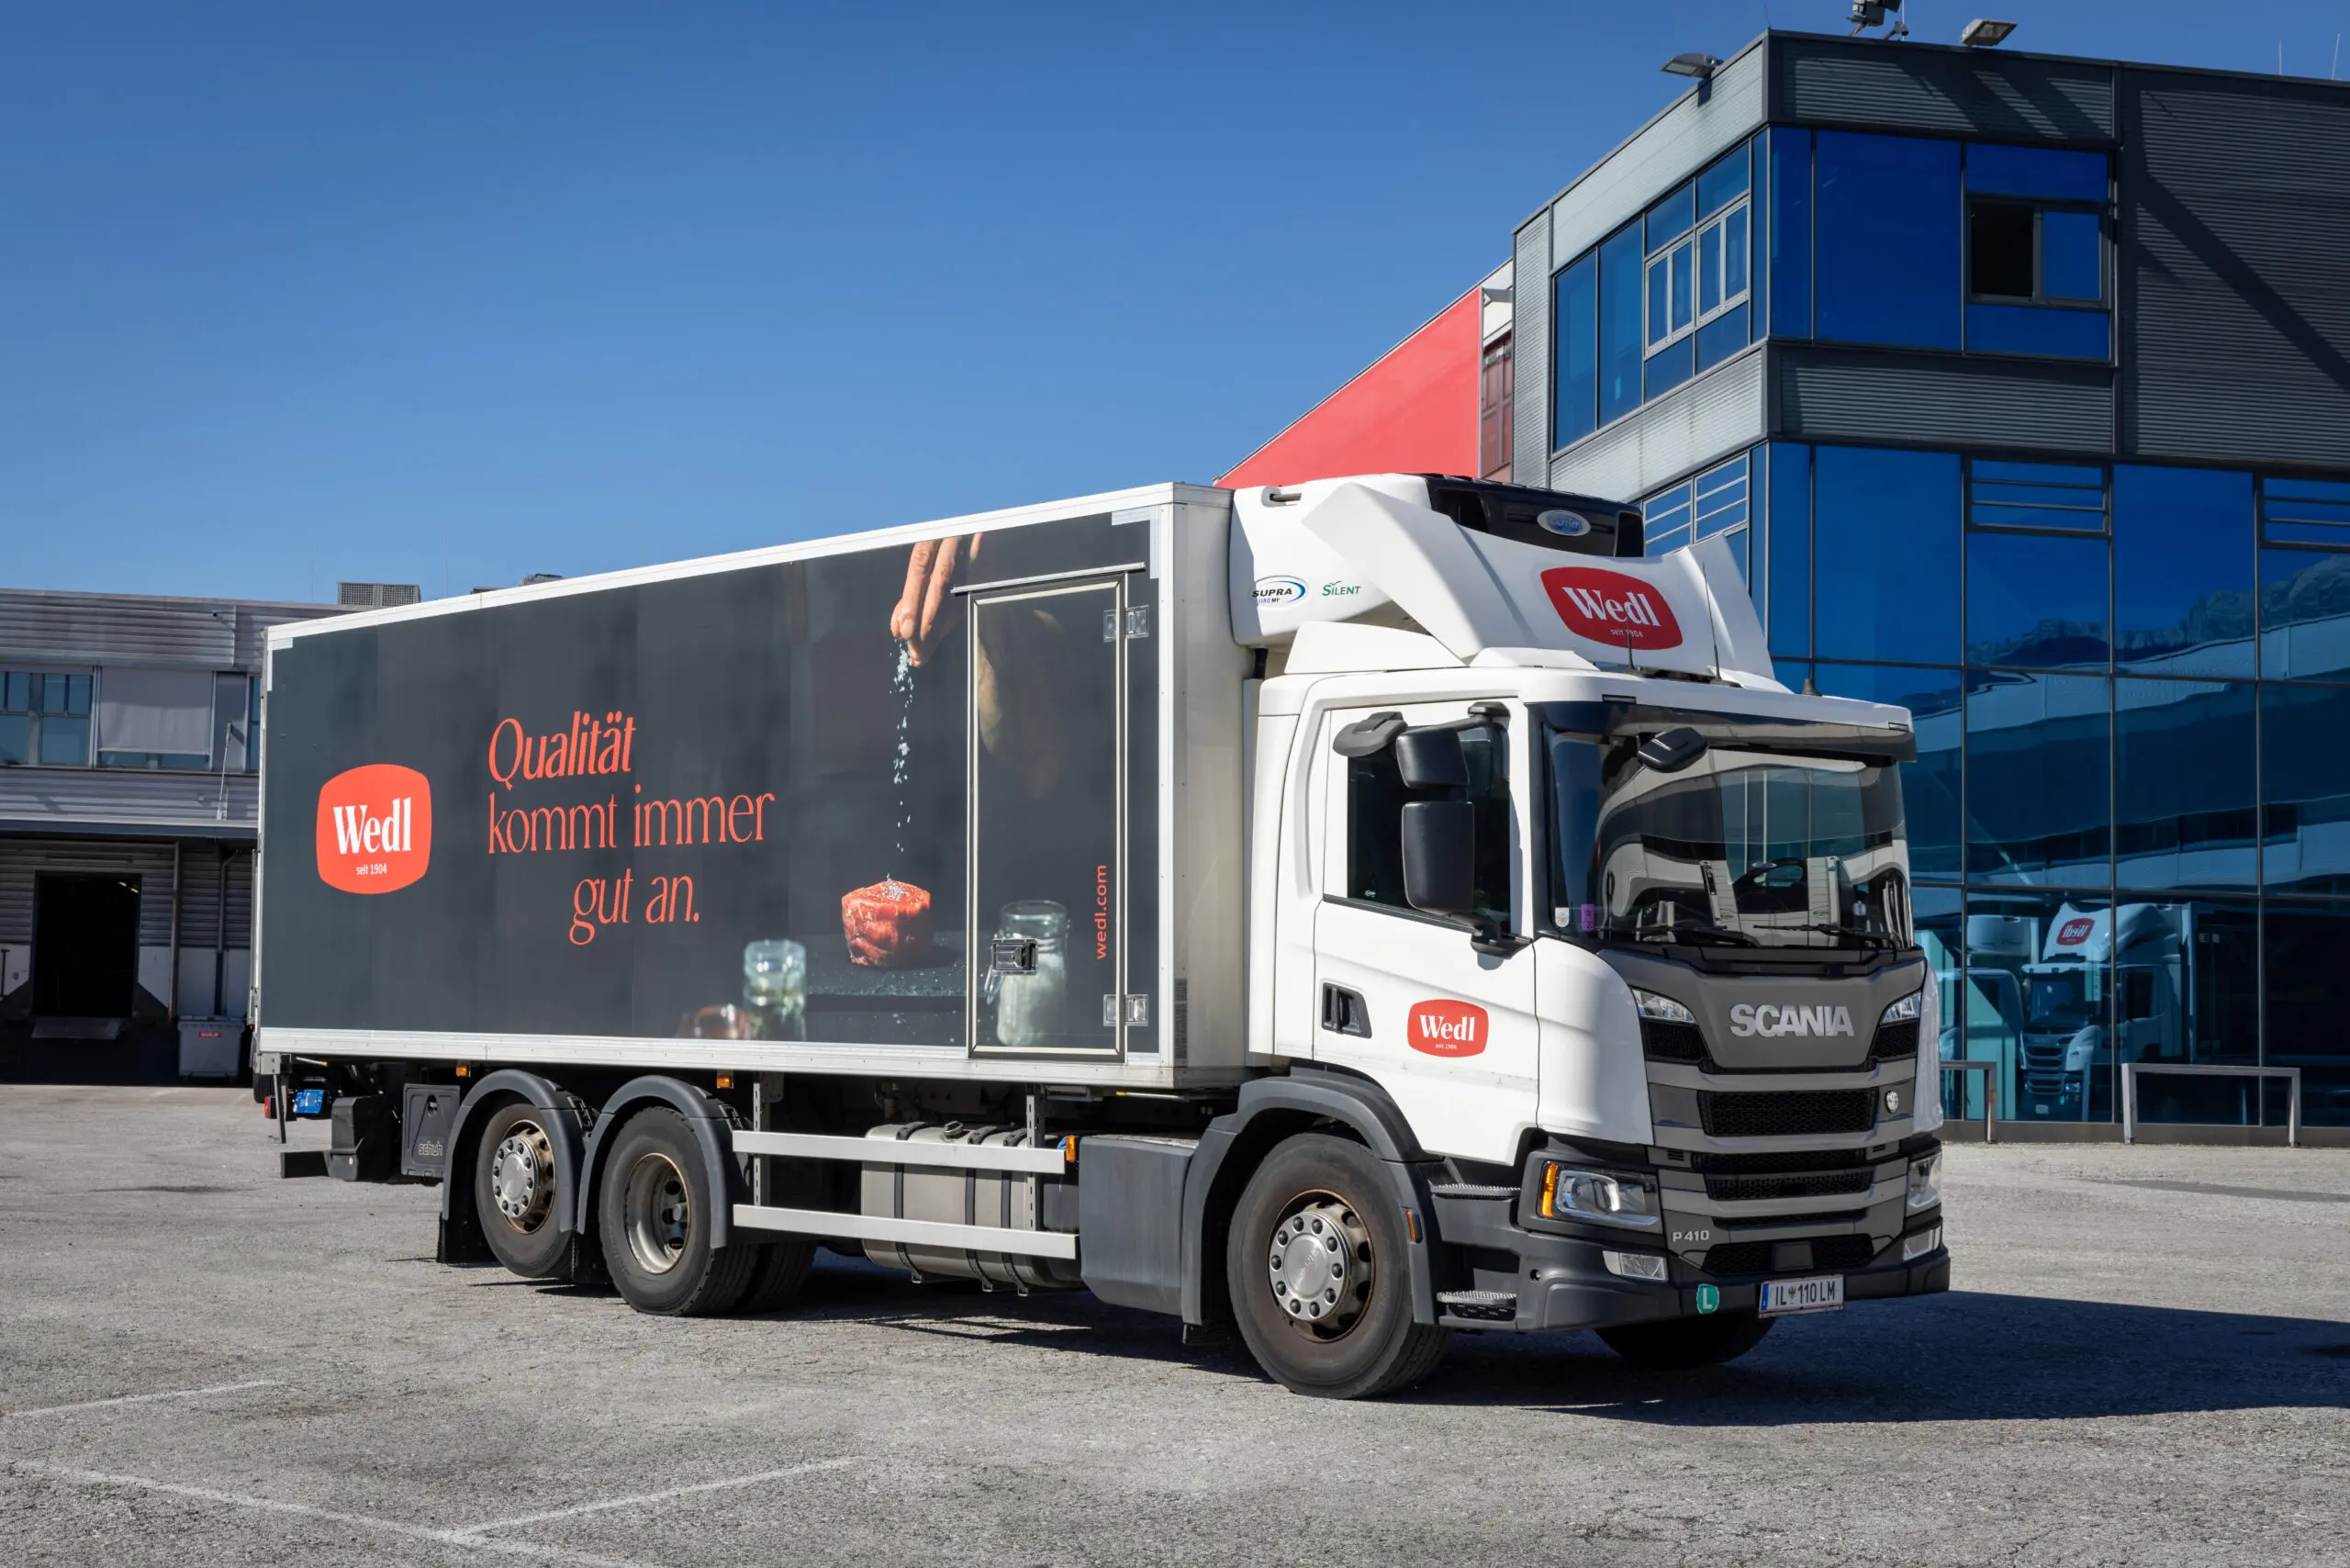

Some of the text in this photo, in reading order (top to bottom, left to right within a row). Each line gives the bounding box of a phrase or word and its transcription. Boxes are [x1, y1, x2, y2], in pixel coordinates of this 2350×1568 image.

[1252, 588, 1292, 598] SUPRA
[1561, 587, 1662, 626] Wedl
[1610, 628, 1626, 636] seit
[489, 711, 635, 790] Qualität
[333, 797, 411, 855] Wedl
[489, 784, 775, 854] kommt immer
[356, 863, 387, 875] seit 1904
[569, 868, 700, 946] gut an.
[1094, 865, 1107, 960] wedl.com
[1419, 1014, 1475, 1042] Wedl
[1729, 1003, 1855, 1037] SCANIA
[1673, 1230, 1709, 1242] P 410
[1702, 1287, 1714, 1309] L
[1775, 1281, 1835, 1306] IL 110 LM
